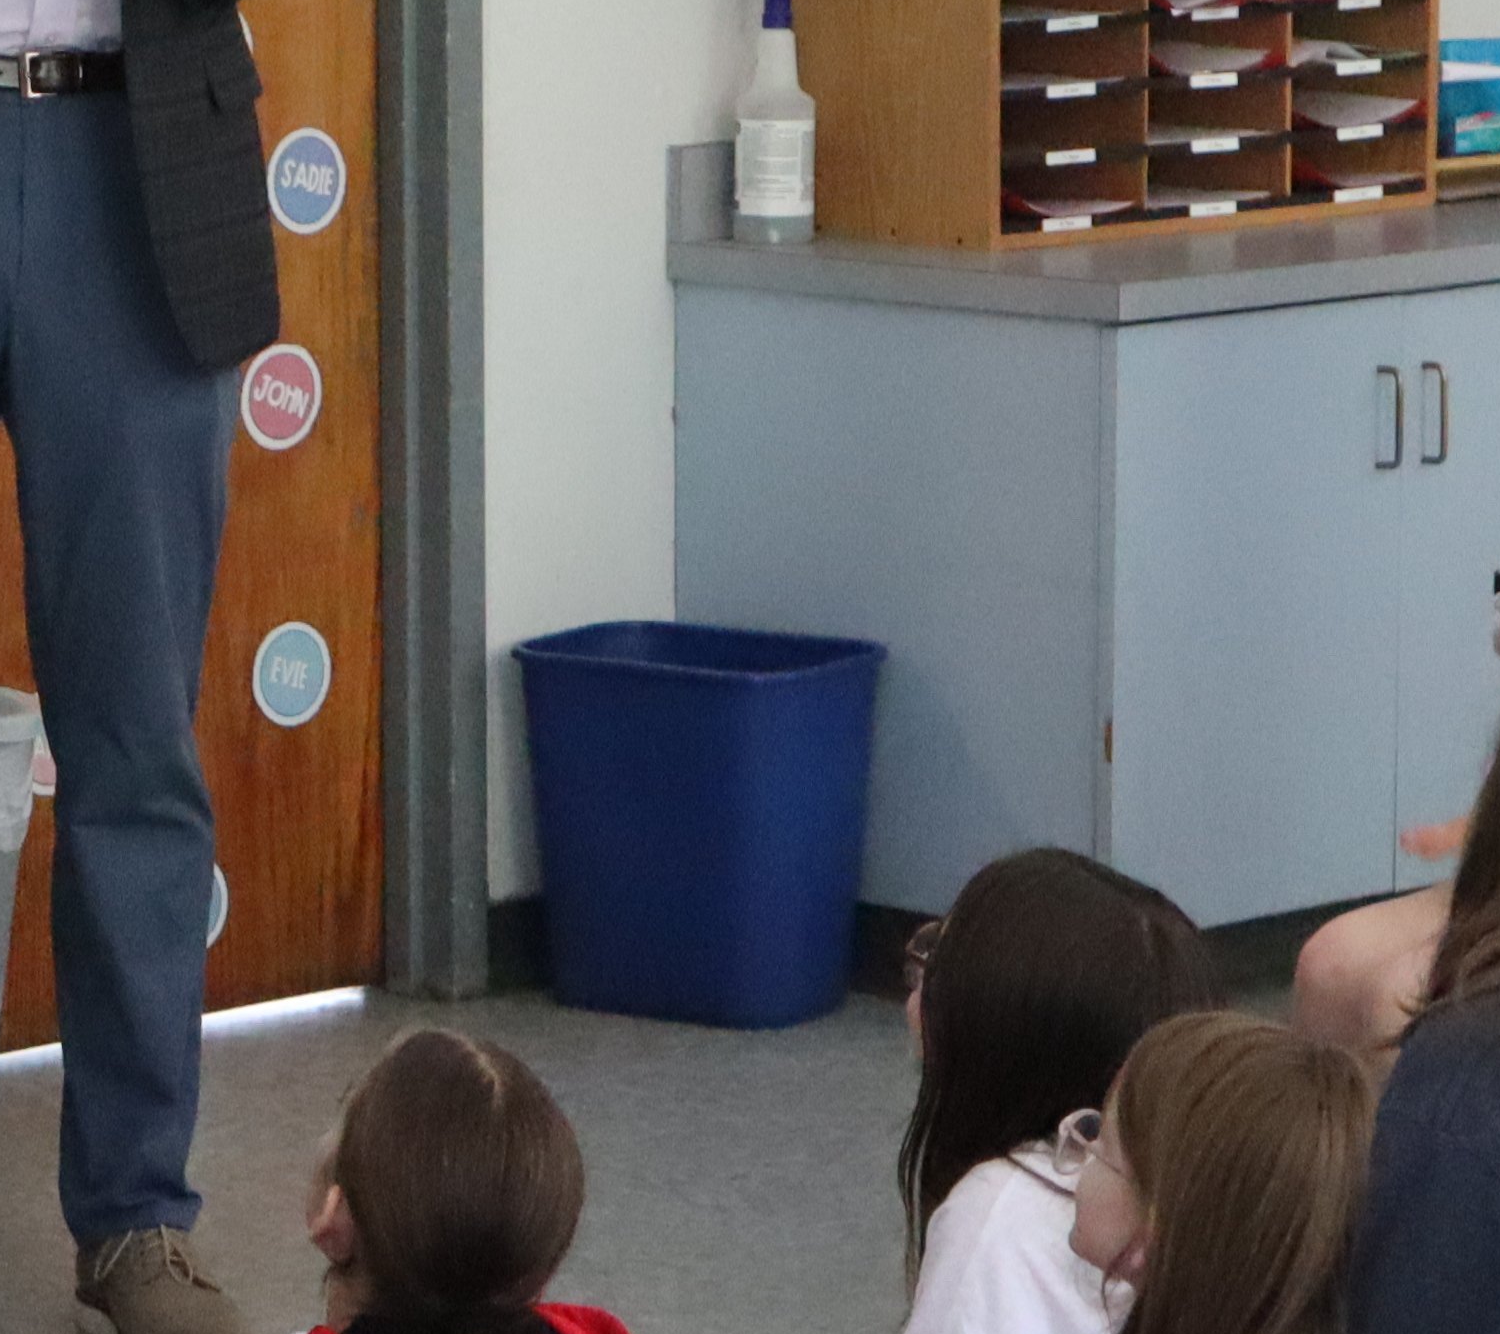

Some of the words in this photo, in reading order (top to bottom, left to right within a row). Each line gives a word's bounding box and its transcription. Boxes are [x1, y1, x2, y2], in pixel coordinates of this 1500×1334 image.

[280, 158, 334, 196] SADIE
[253, 374, 310, 419] JOHN
[270, 658, 308, 691] EVIE
